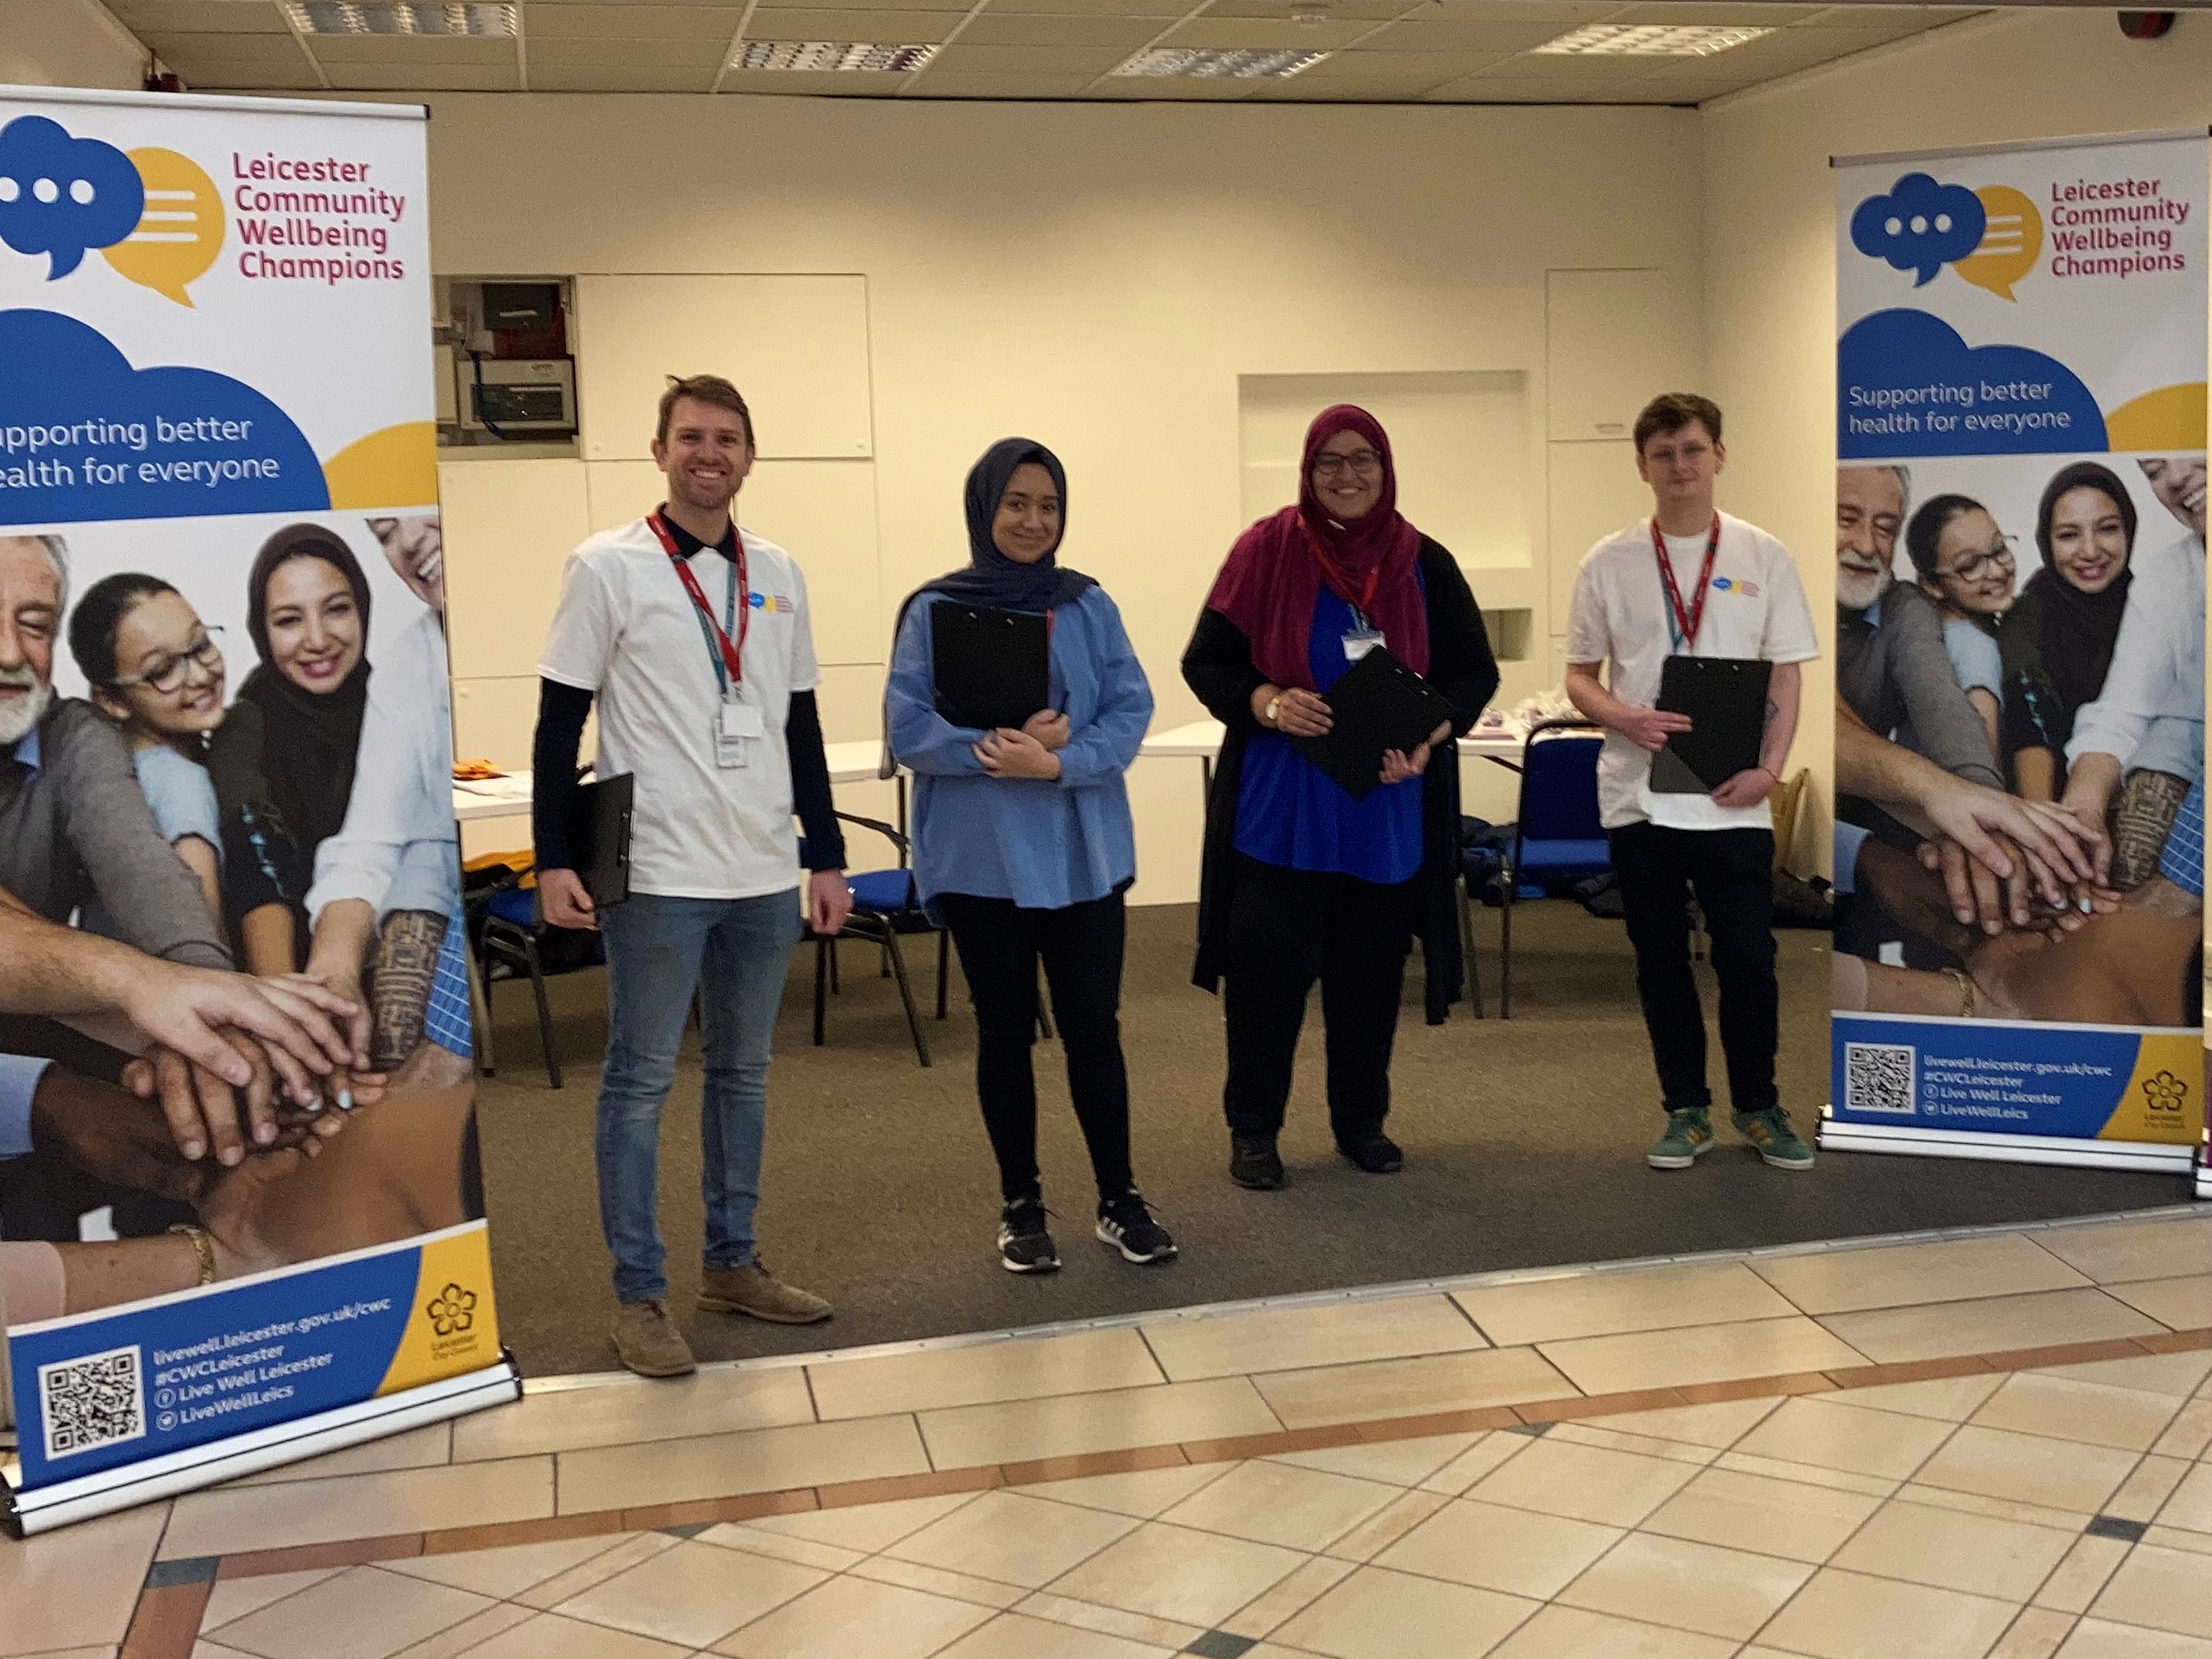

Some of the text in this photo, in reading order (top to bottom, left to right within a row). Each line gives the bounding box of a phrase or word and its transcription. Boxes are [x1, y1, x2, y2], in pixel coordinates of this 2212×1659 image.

[232, 153, 370, 182] Leicester
[235, 185, 405, 223] Community
[2051, 179, 2160, 202] Leicester
[2051, 199, 2190, 227] Community
[236, 219, 388, 254] Wellbeing
[2051, 227, 2171, 252] Wellbeing
[239, 252, 404, 285] Champions
[2051, 250, 2186, 279] Champions
[1849, 380, 2054, 409] Supporting better
[0, 416, 253, 454] pporting better
[1849, 408, 2071, 435] health for everyone
[82, 455, 130, 484] for
[138, 455, 280, 487] everyone
[1941, 1087, 2063, 1106] Live Well Leicester
[153, 1298, 391, 1366] livewell.leicester.gov.uk/cwc
[154, 1344, 285, 1387] #CWCLeicester
[179, 1353, 334, 1402] Live Well Leicester
[180, 1386, 295, 1424] LiveWellLeics
